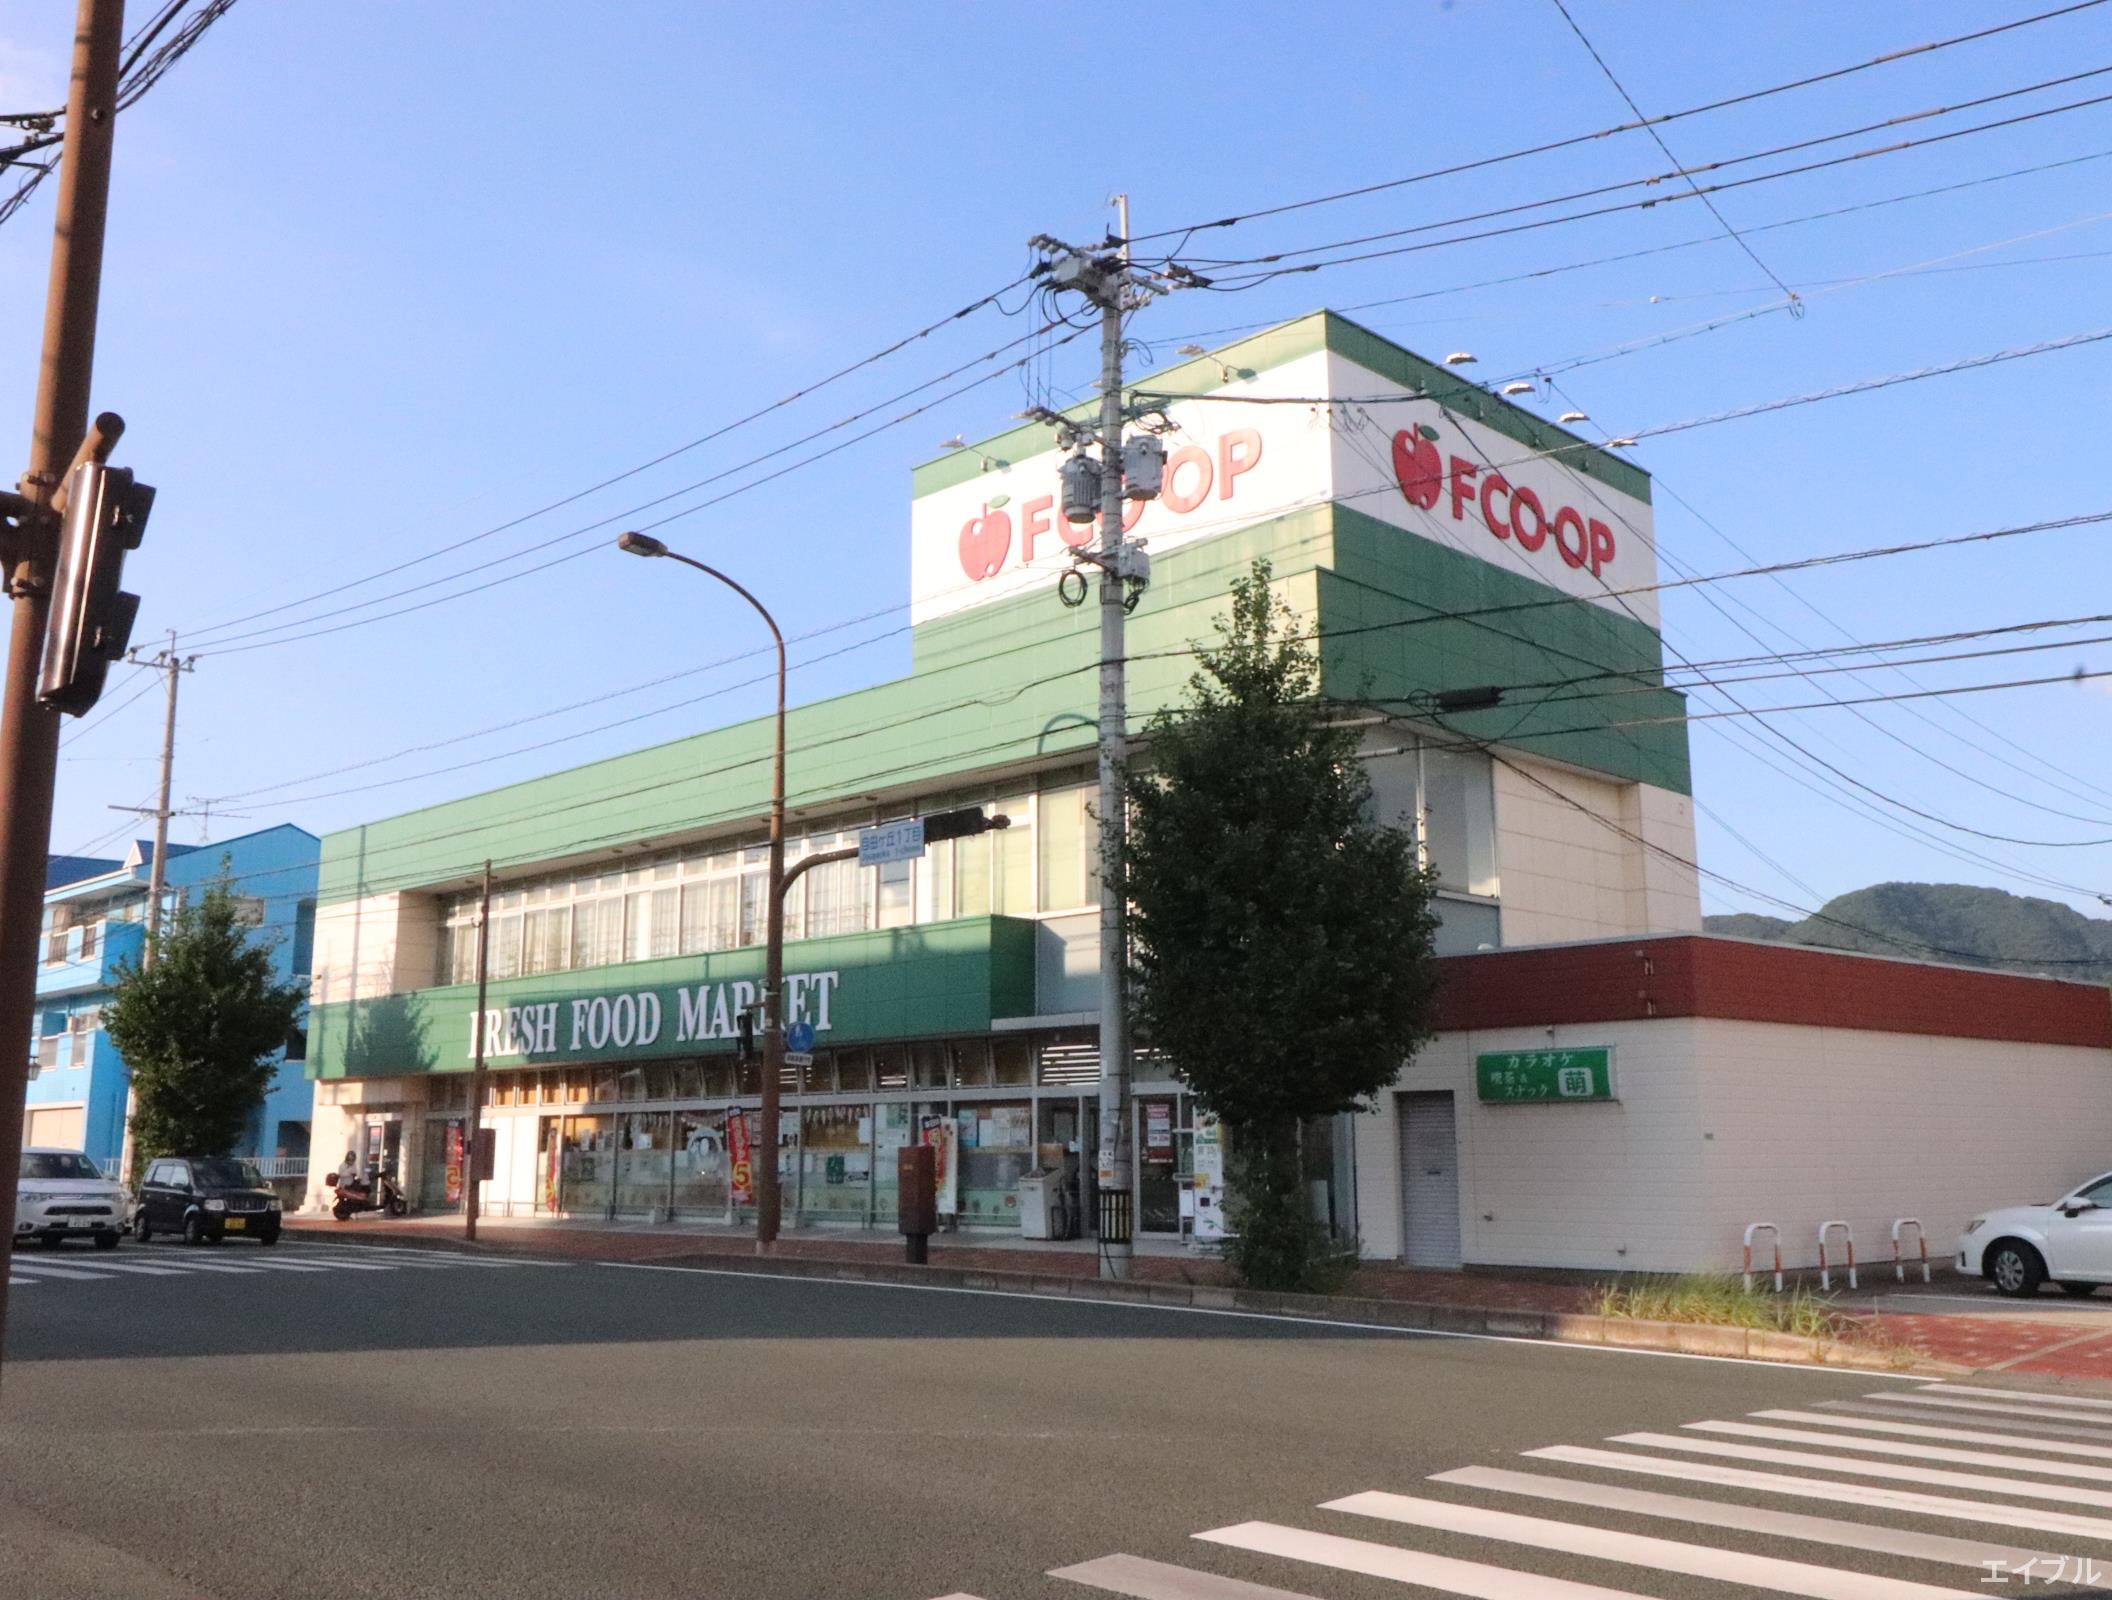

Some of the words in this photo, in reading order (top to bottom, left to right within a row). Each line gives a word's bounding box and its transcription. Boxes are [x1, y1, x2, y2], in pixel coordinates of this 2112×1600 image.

[1450, 454, 1616, 577] FCO-OP
[570, 991, 661, 1050] FOOD
[1508, 1053, 1573, 1068] カラオケ
[1504, 1083, 1549, 1097] スナック
[1565, 1070, 1587, 1095] 萌
